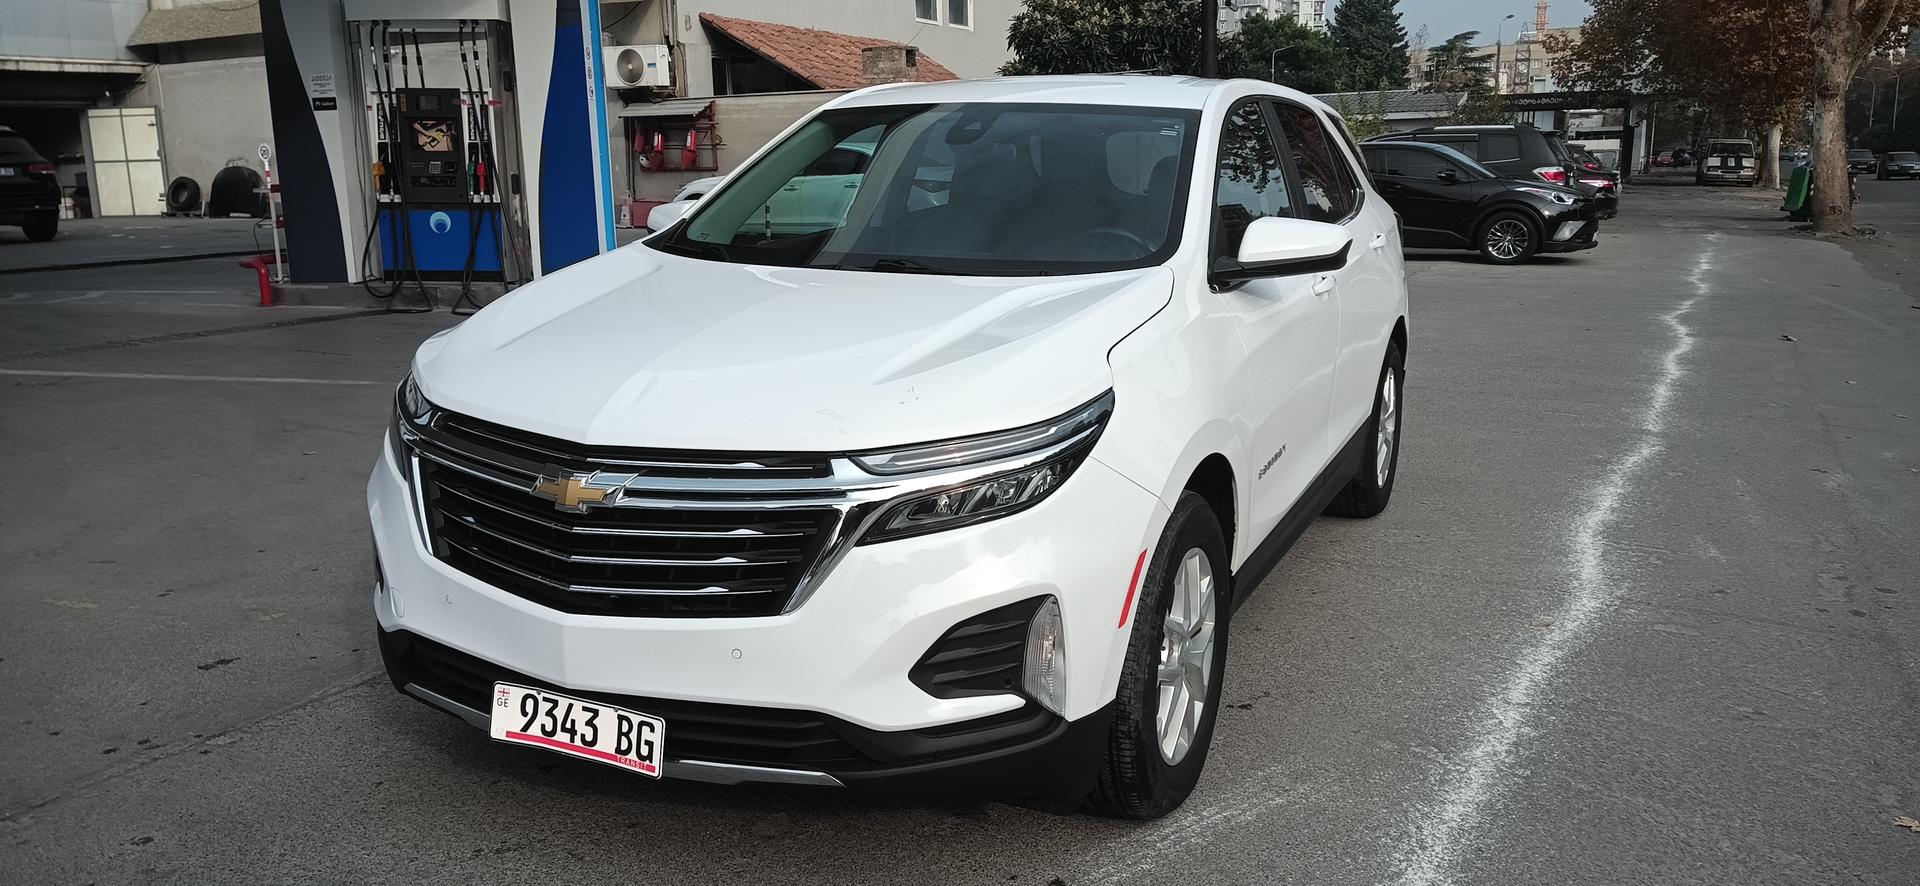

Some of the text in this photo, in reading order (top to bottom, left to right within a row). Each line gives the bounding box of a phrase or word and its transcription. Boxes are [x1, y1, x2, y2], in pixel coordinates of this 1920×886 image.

[496, 698, 509, 708] GE
[519, 693, 655, 764] 9343 BG
[617, 756, 648, 770] TRANSIT
